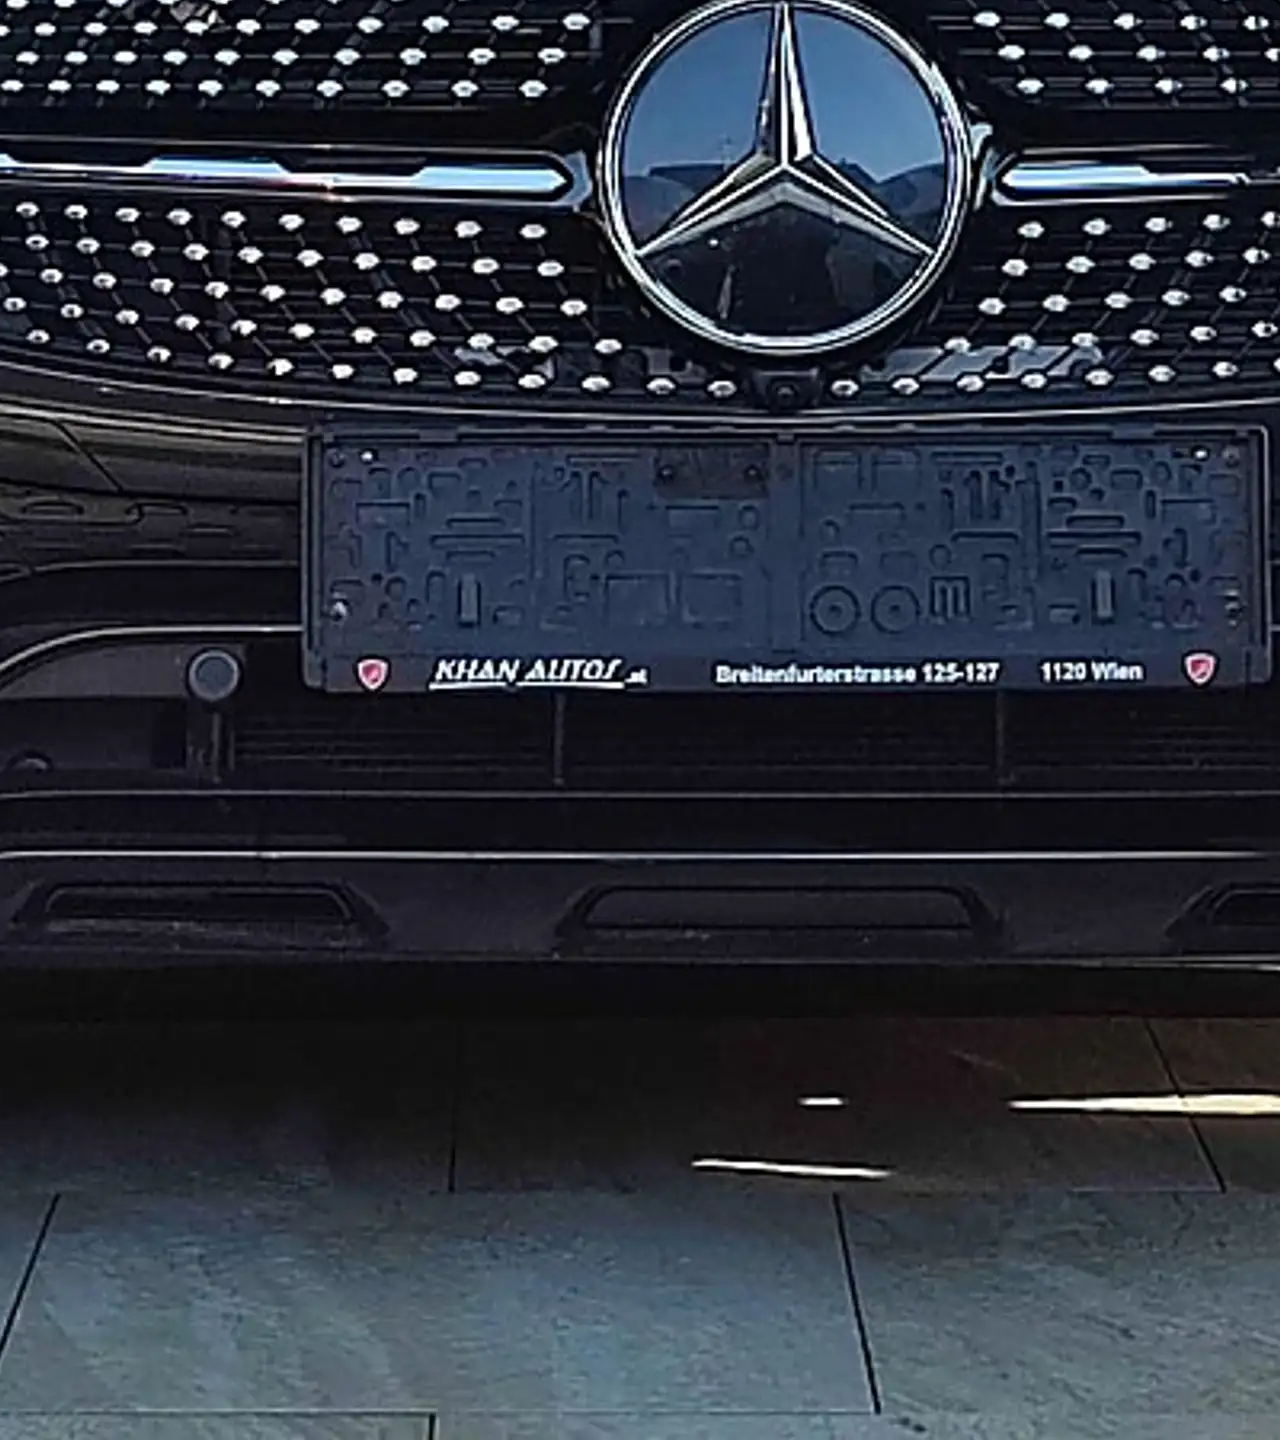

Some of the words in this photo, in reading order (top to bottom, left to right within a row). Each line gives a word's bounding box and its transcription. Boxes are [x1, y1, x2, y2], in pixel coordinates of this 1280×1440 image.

[434, 658, 520, 682] KHAN
[921, 661, 1000, 683] 125-127
[1040, 661, 1087, 683] 1120
[1091, 660, 1144, 682] Wien
